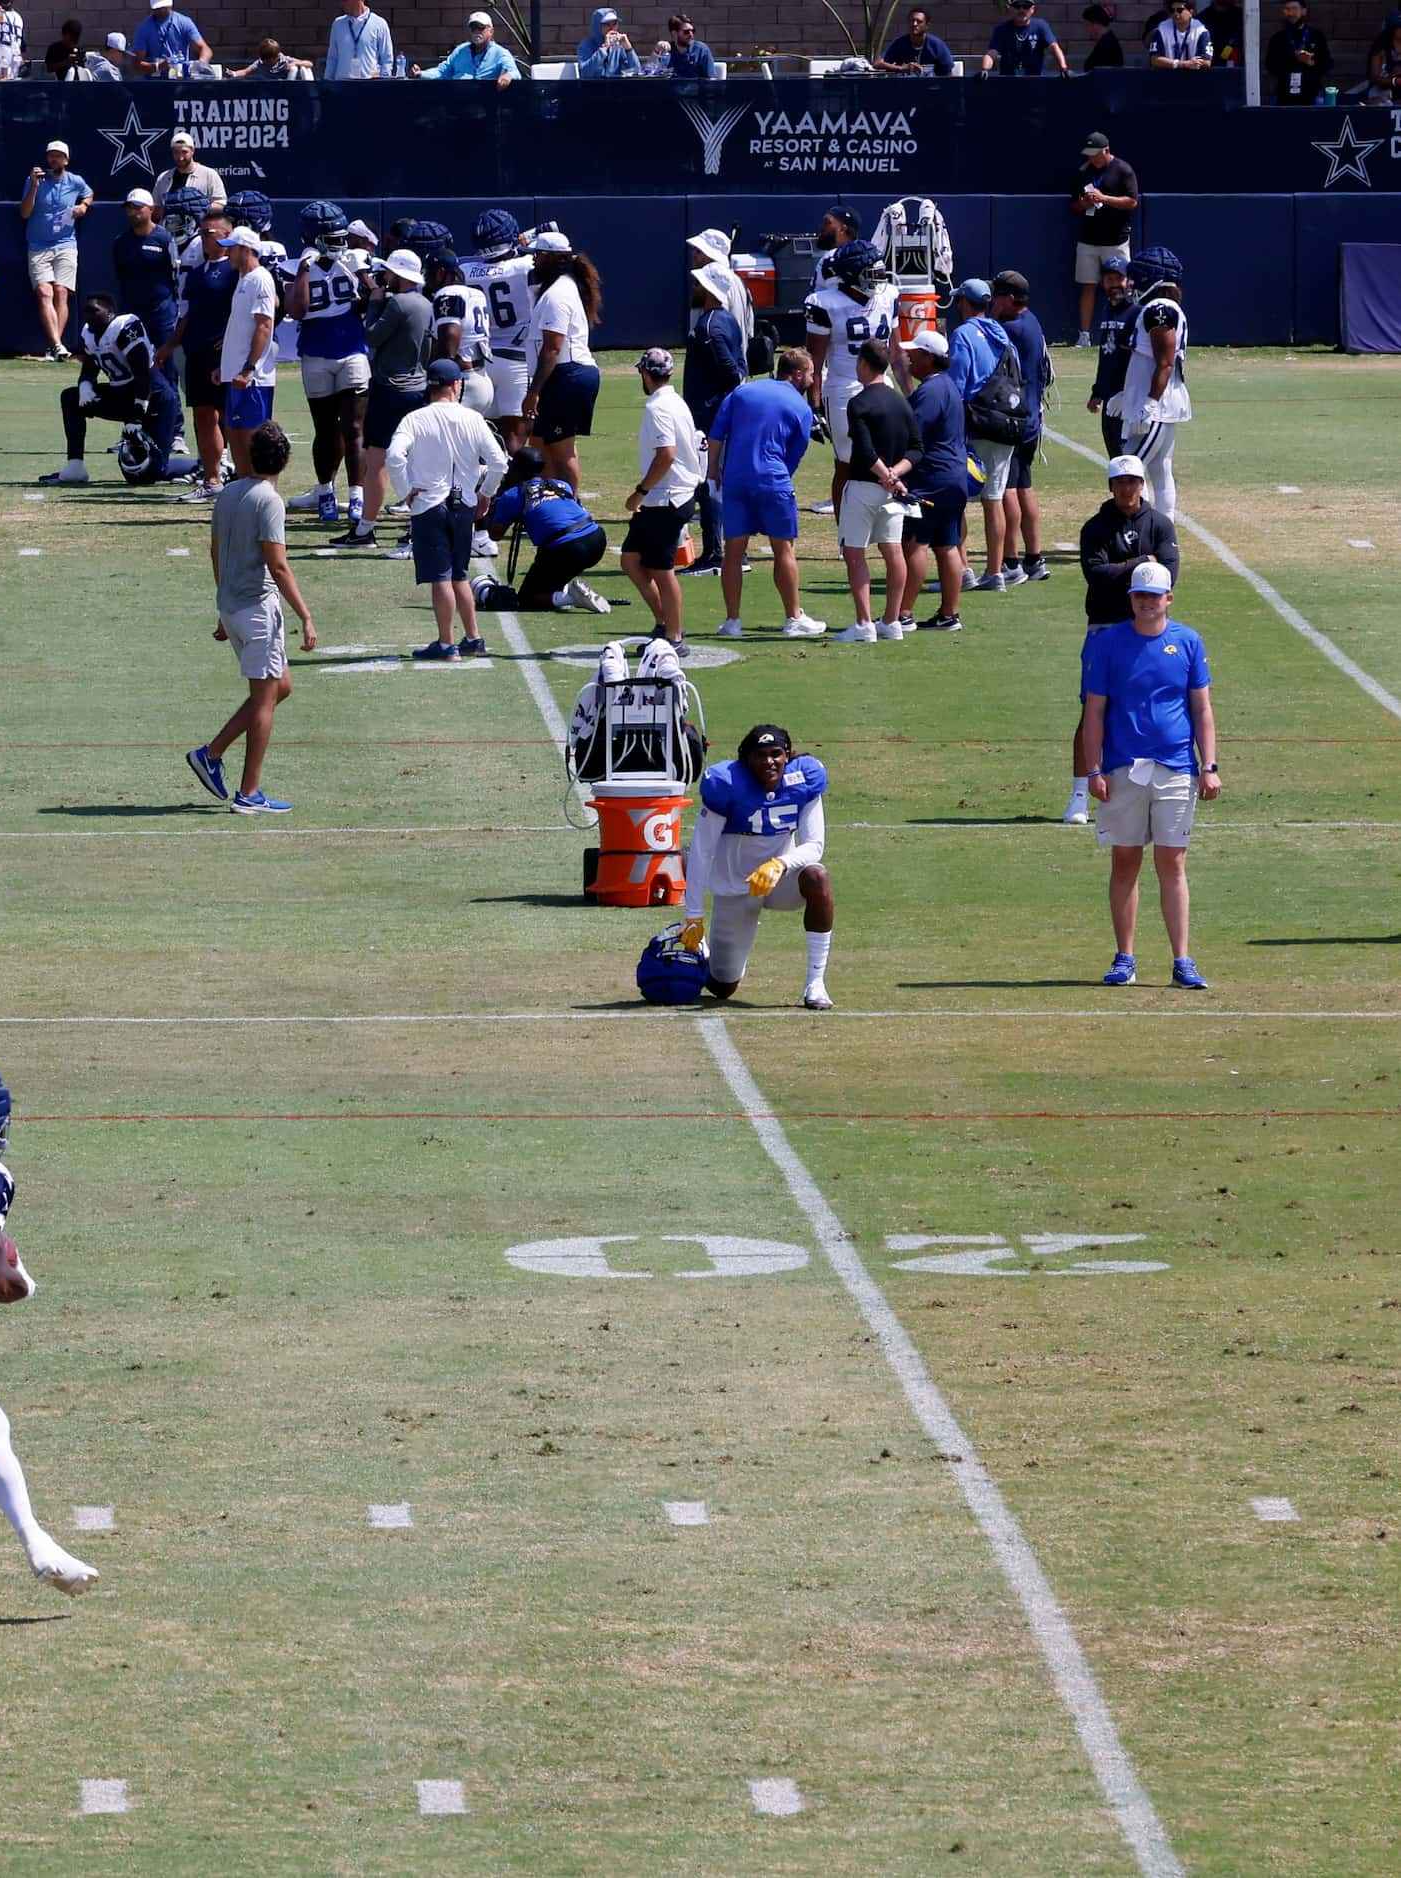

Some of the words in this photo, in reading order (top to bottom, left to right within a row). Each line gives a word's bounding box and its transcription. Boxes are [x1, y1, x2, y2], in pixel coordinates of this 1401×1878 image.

[173, 99, 290, 122] TRAINING
[749, 138, 824, 154] RESORT
[828, 138, 841, 153] &
[847, 139, 918, 155] CASINO
[778, 157, 817, 171] SAN
[822, 157, 901, 172] MANUEL
[747, 803, 799, 834] 15
[643, 813, 674, 851] G
